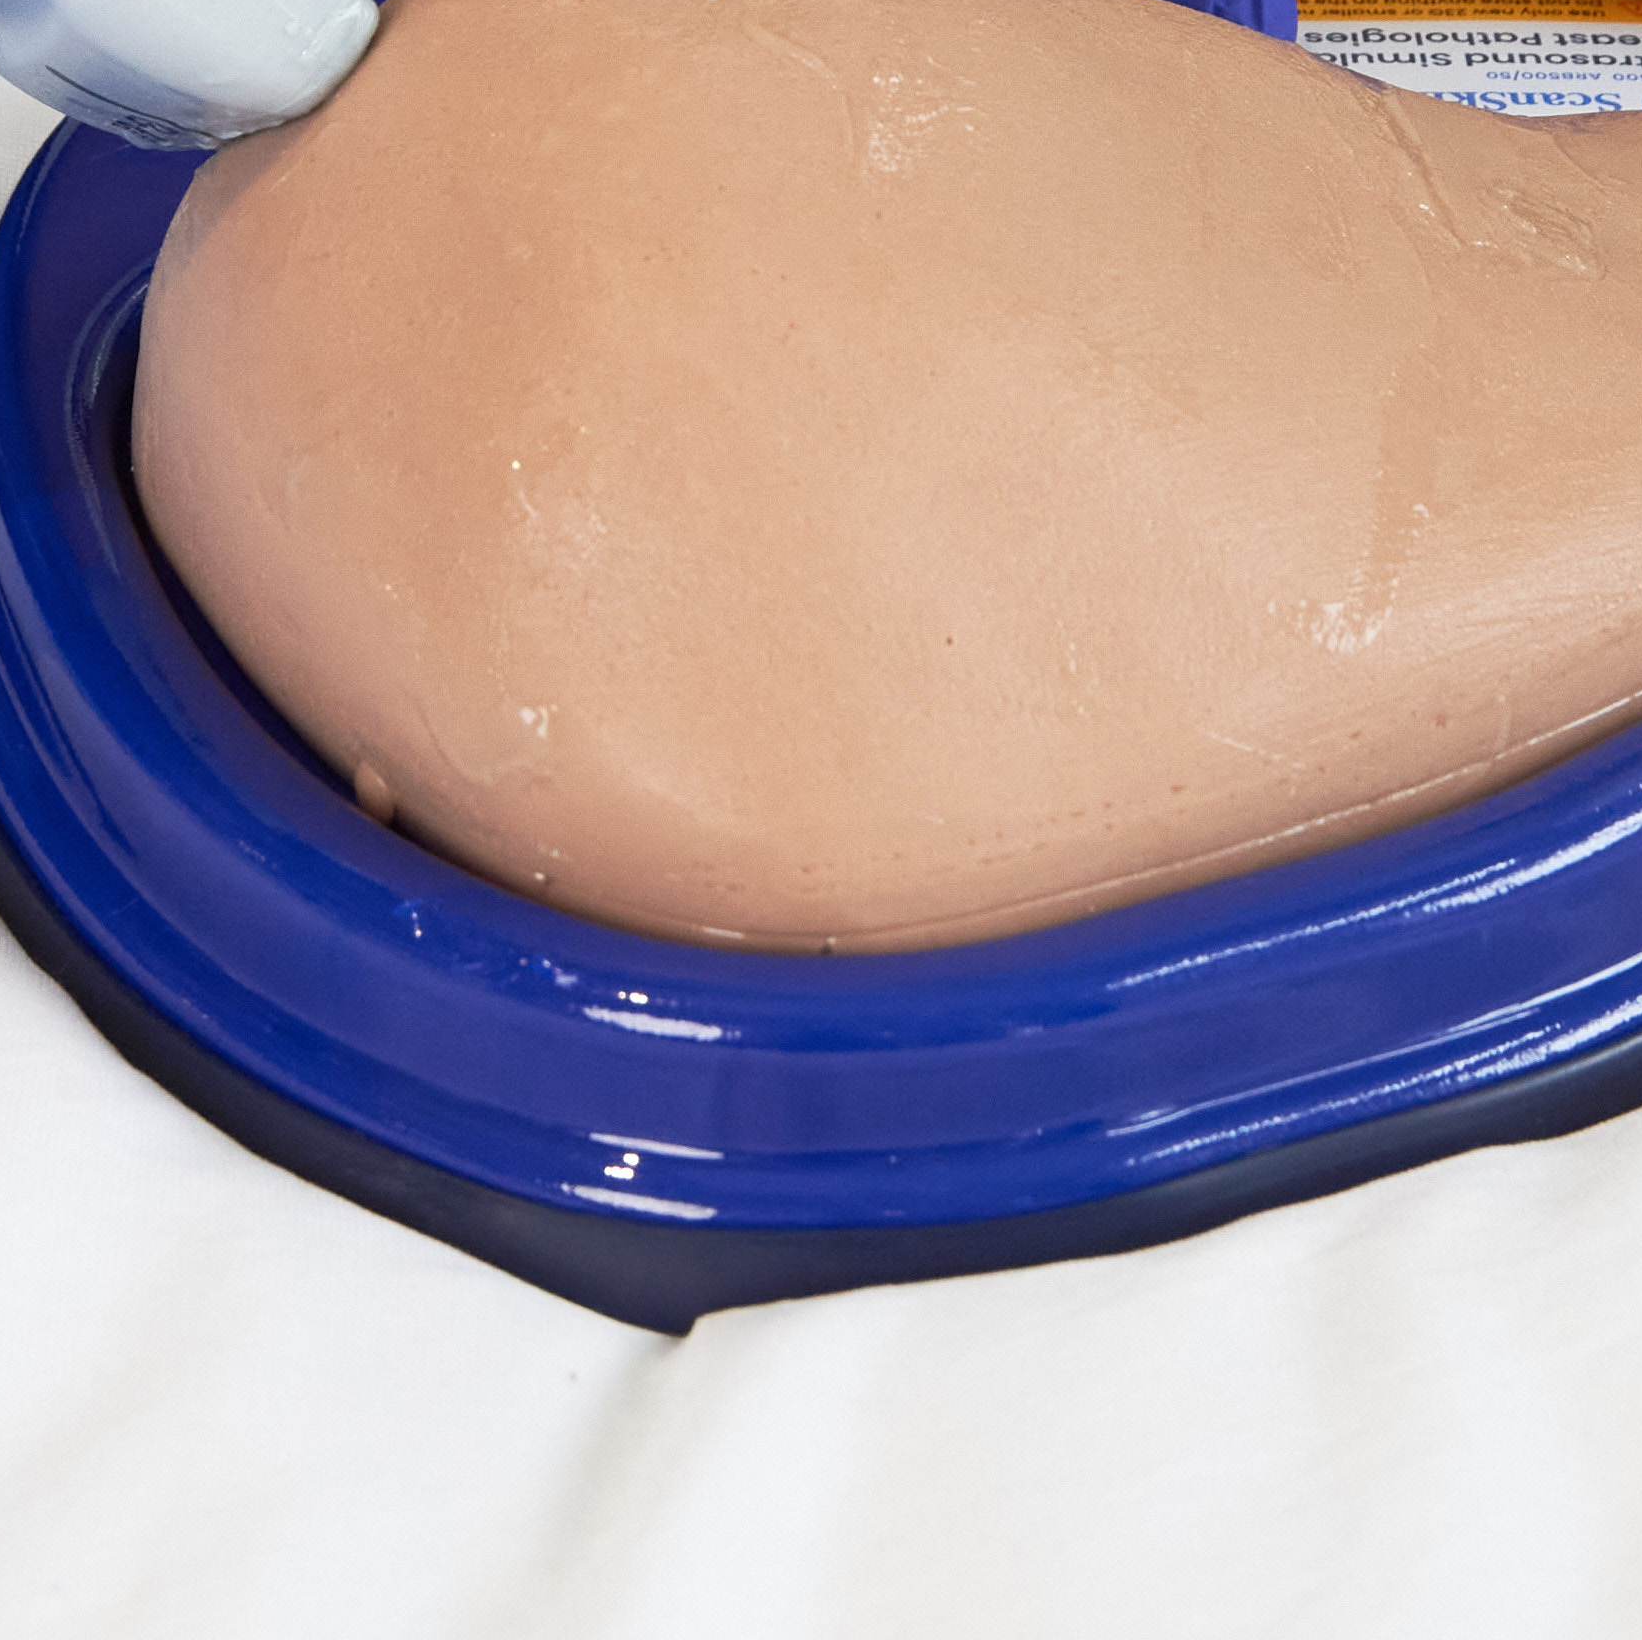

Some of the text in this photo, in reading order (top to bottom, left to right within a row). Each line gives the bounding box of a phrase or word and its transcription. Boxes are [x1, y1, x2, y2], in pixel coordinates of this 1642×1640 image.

[1575, 0, 1603, 7] Do
[1321, 8, 1397, 17] smaller
[1473, 8, 1514, 16] new
[1520, 7, 1563, 17] only
[1570, 9, 1605, 18] Use
[1304, 28, 1543, 47] Pathologies
[1486, 71, 1601, 81] ARB500/50
[1419, 91, 1622, 111] ScanSk
